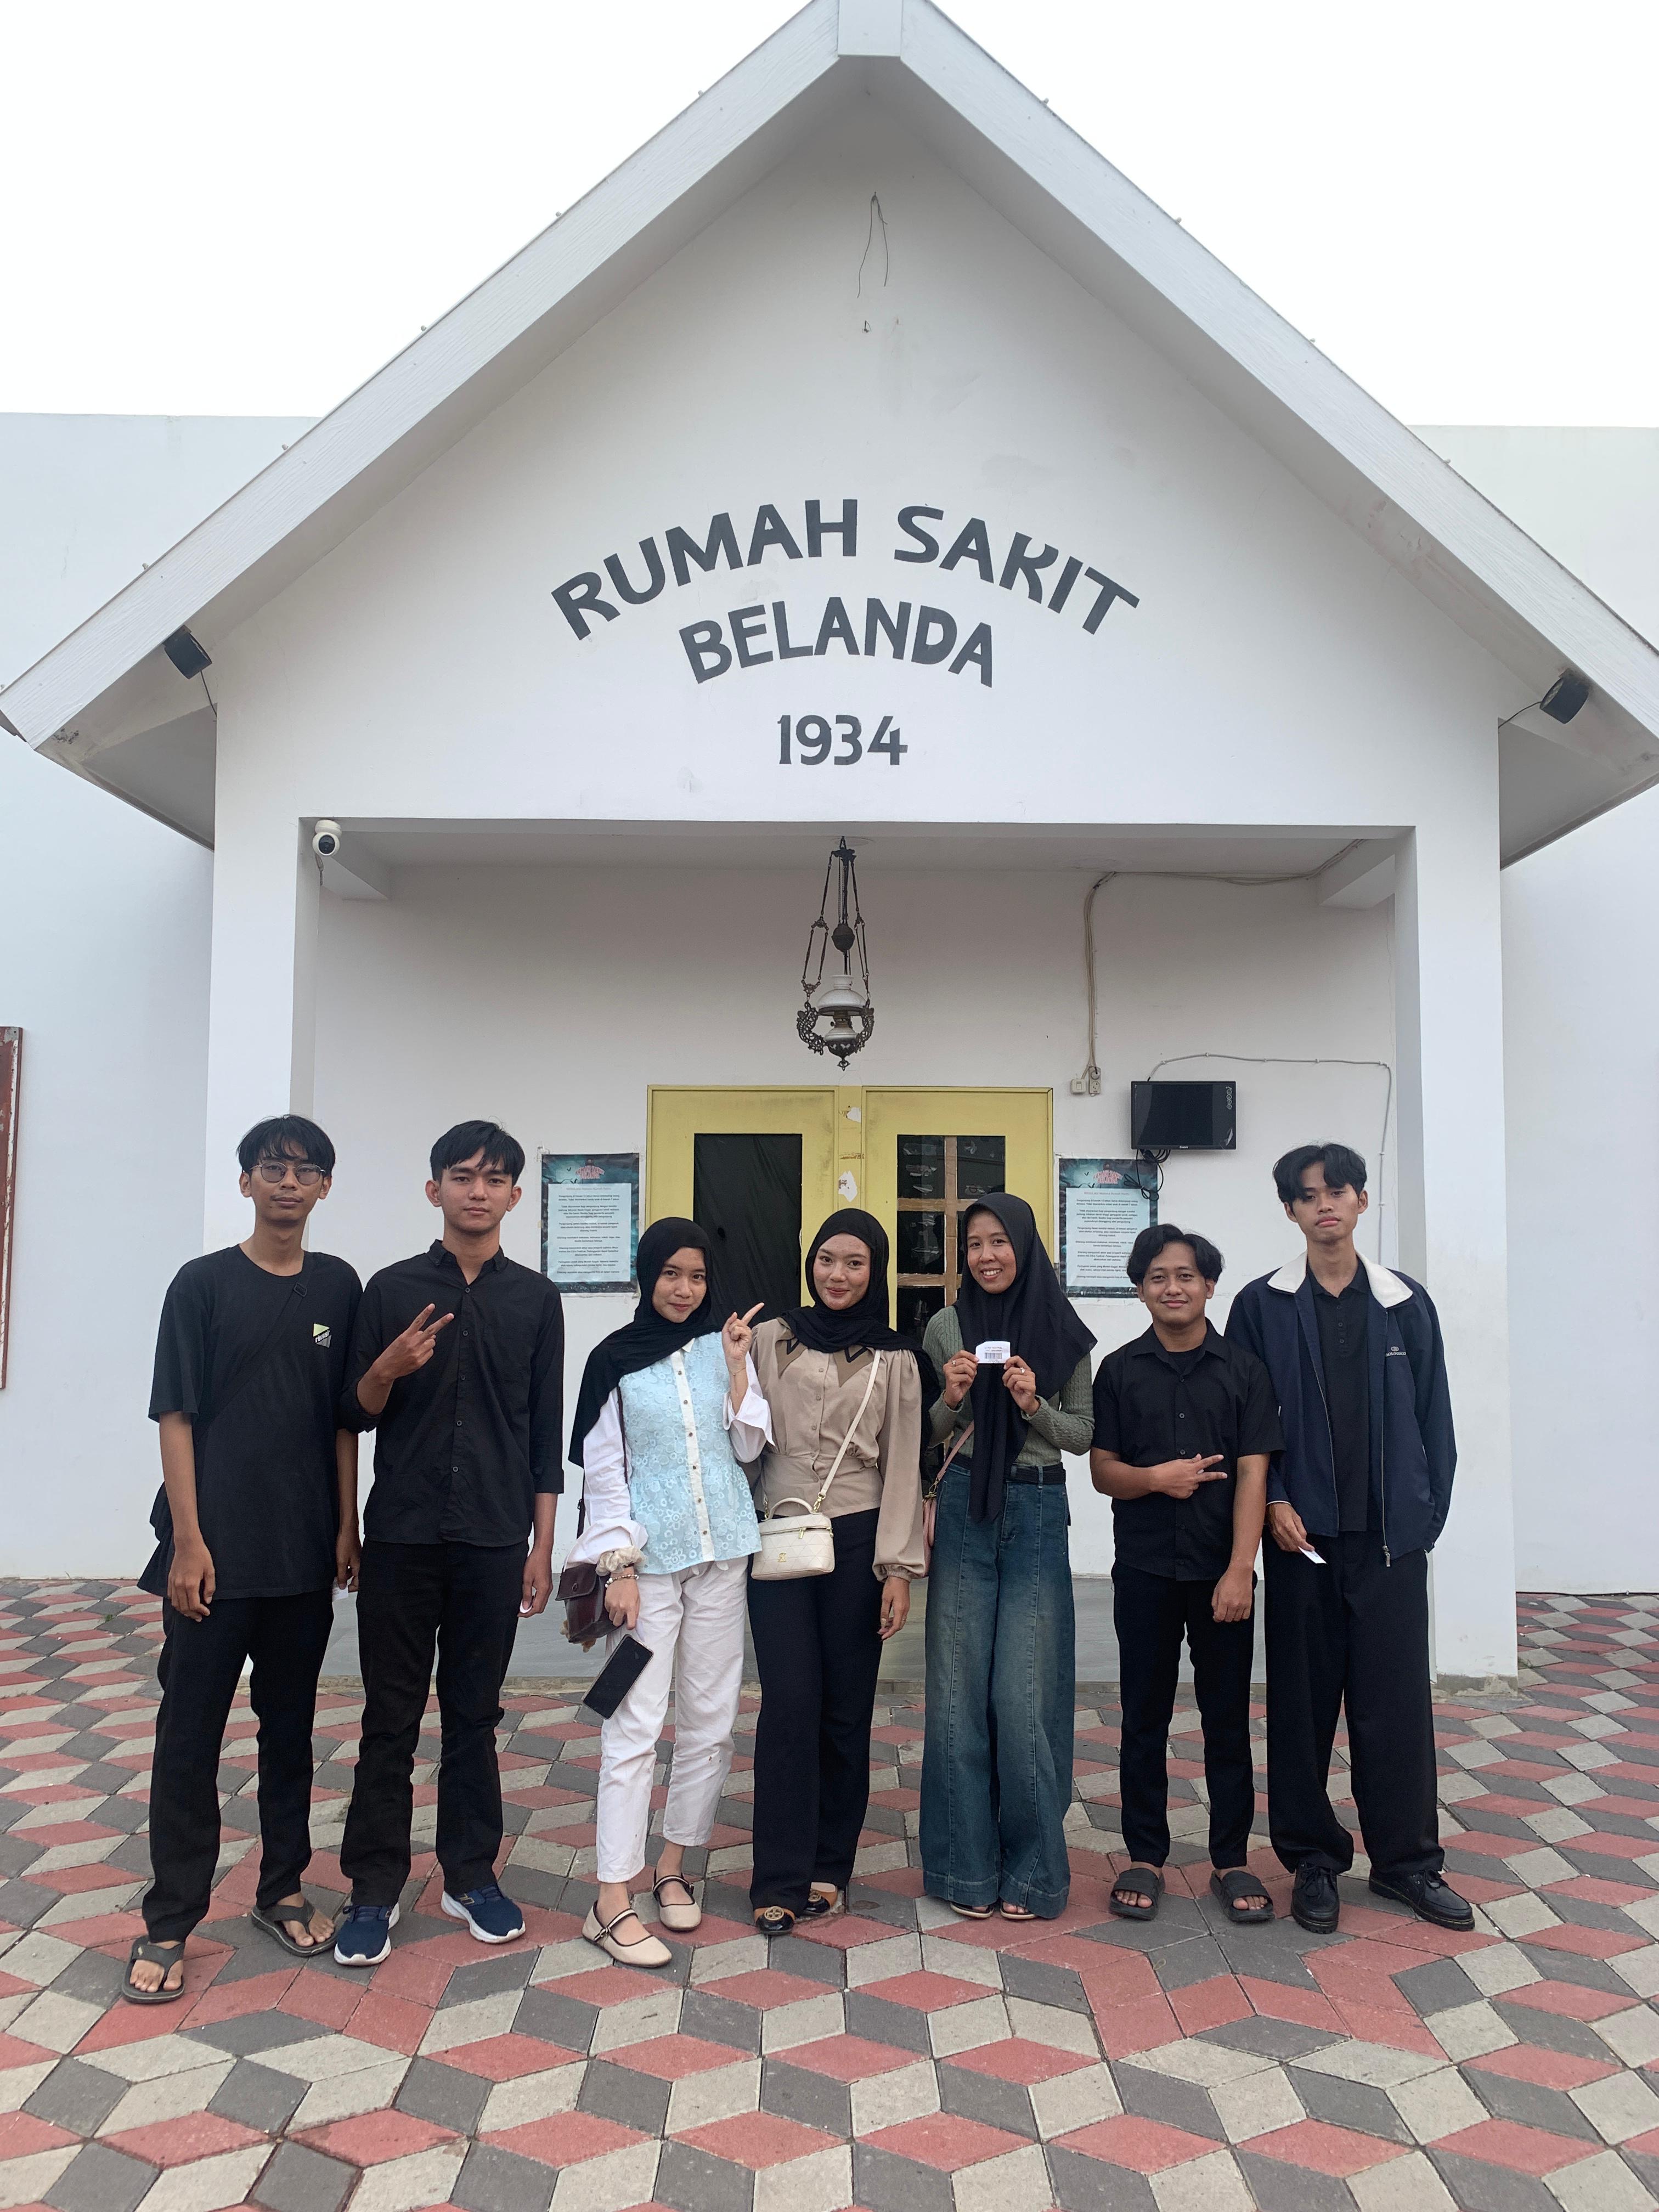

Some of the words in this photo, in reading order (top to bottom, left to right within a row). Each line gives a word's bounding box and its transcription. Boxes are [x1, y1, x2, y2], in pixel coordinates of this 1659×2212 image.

[551, 499, 858, 640] RUMAH
[894, 505, 1139, 635] SAKIT
[679, 597, 992, 687] BELANDA
[777, 715, 907, 765] 1934
